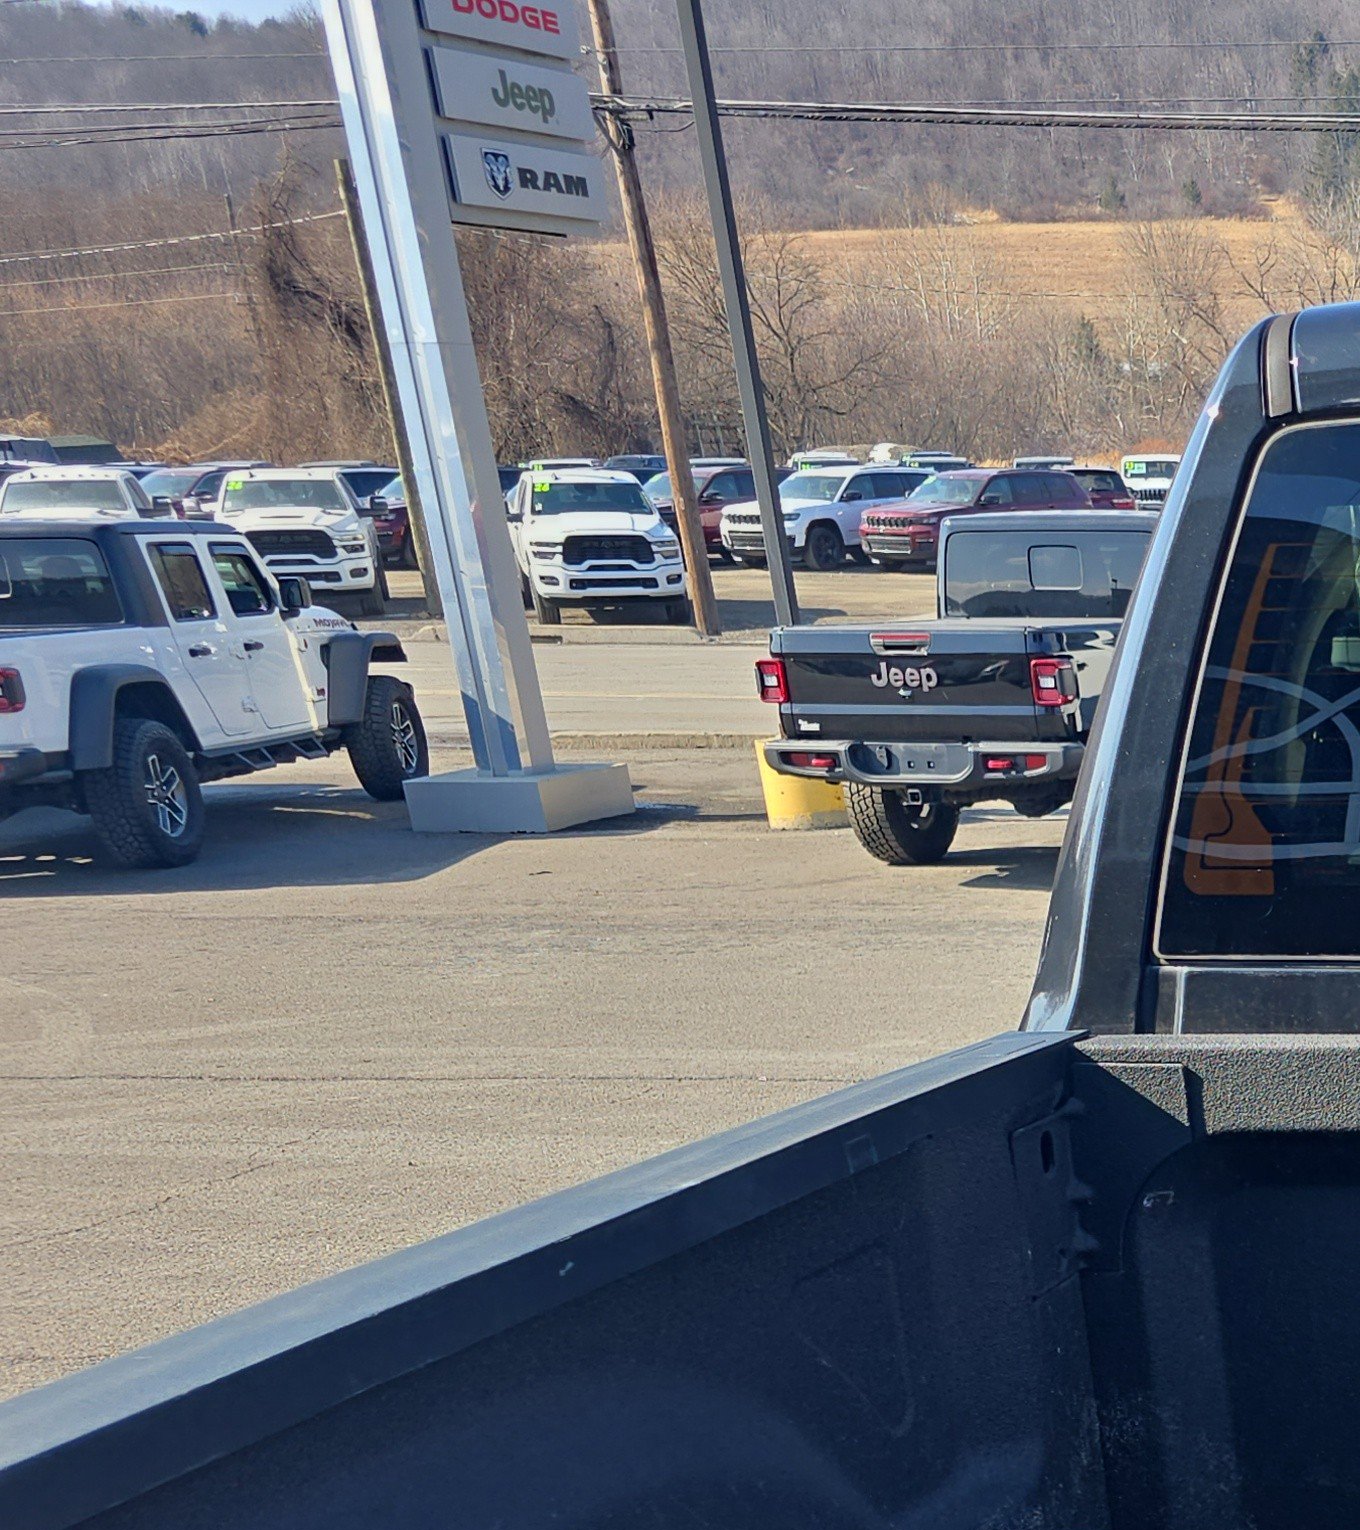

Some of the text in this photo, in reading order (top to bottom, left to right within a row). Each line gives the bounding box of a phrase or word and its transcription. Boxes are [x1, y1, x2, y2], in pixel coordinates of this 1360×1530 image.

[451, 0, 560, 35] DODGE
[491, 69, 555, 124] Jeep
[517, 167, 590, 198] RAM
[871, 661, 938, 693] Jeep
